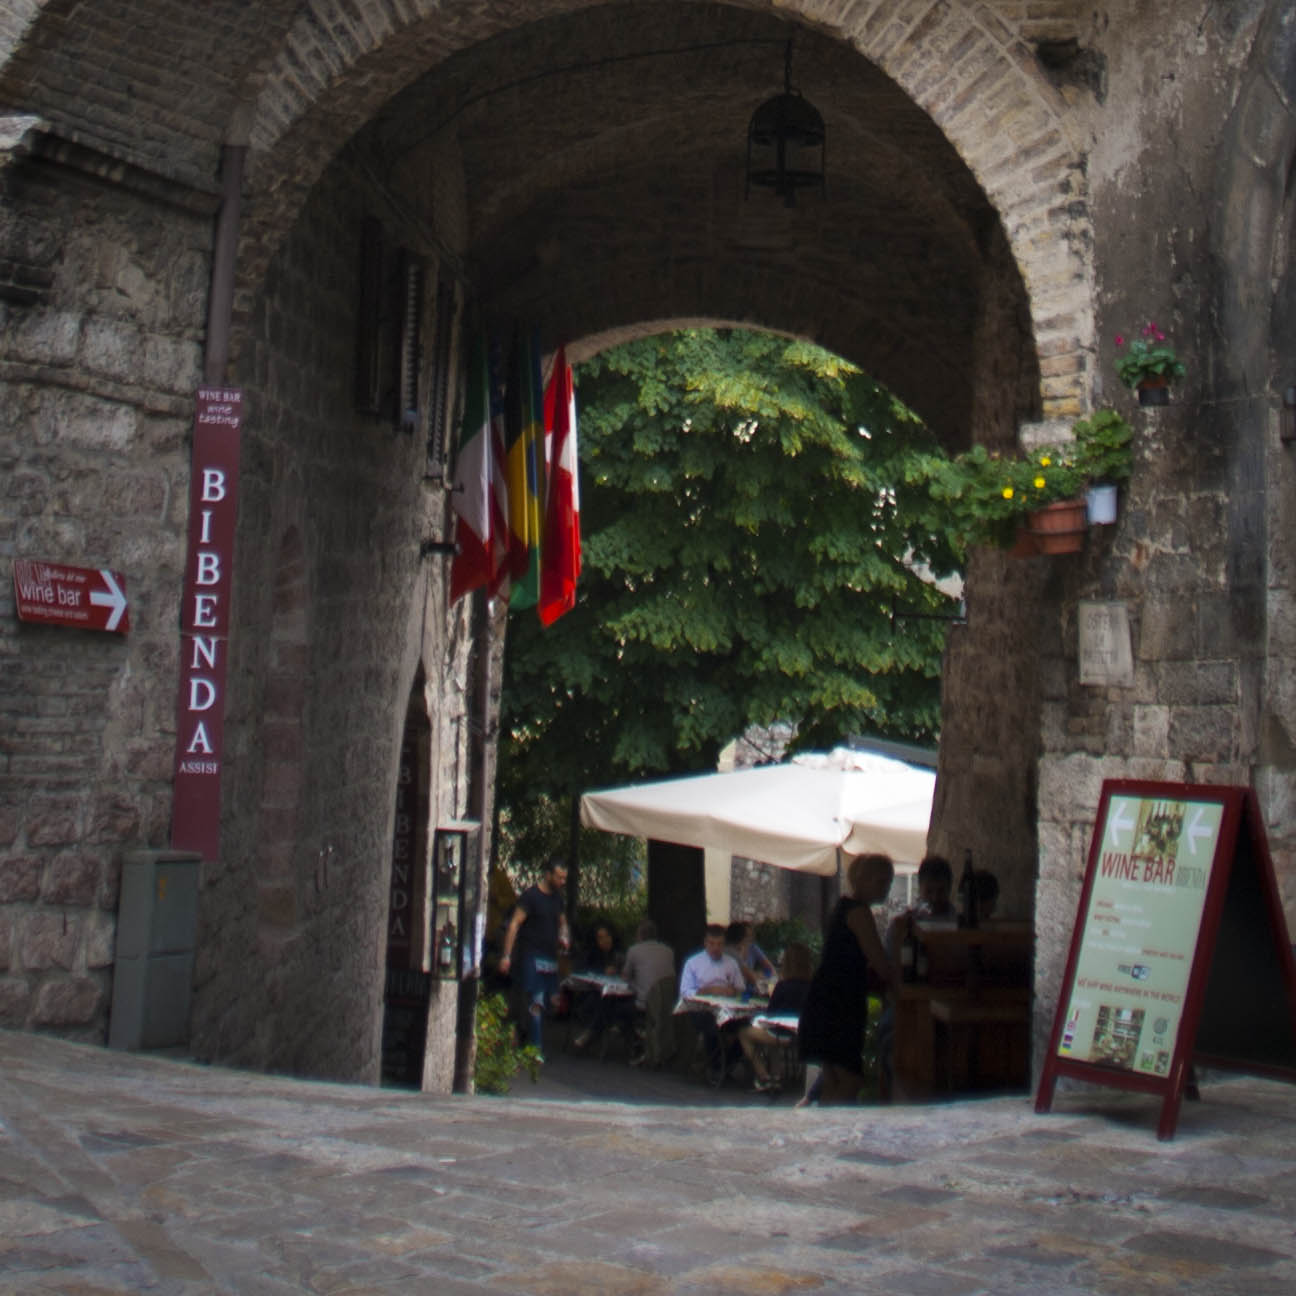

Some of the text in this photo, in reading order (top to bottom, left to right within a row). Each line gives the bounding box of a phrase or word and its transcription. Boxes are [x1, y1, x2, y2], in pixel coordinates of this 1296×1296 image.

[198, 390, 241, 403] WINE BAR
[207, 405, 233, 415] wine
[198, 413, 240, 429] tasting
[18, 582, 82, 607] wine bar
[187, 468, 226, 755] BIBENDA
[179, 761, 219, 774] ASSISI
[1101, 852, 1141, 881] WINE
[1144, 856, 1176, 886] BAR
